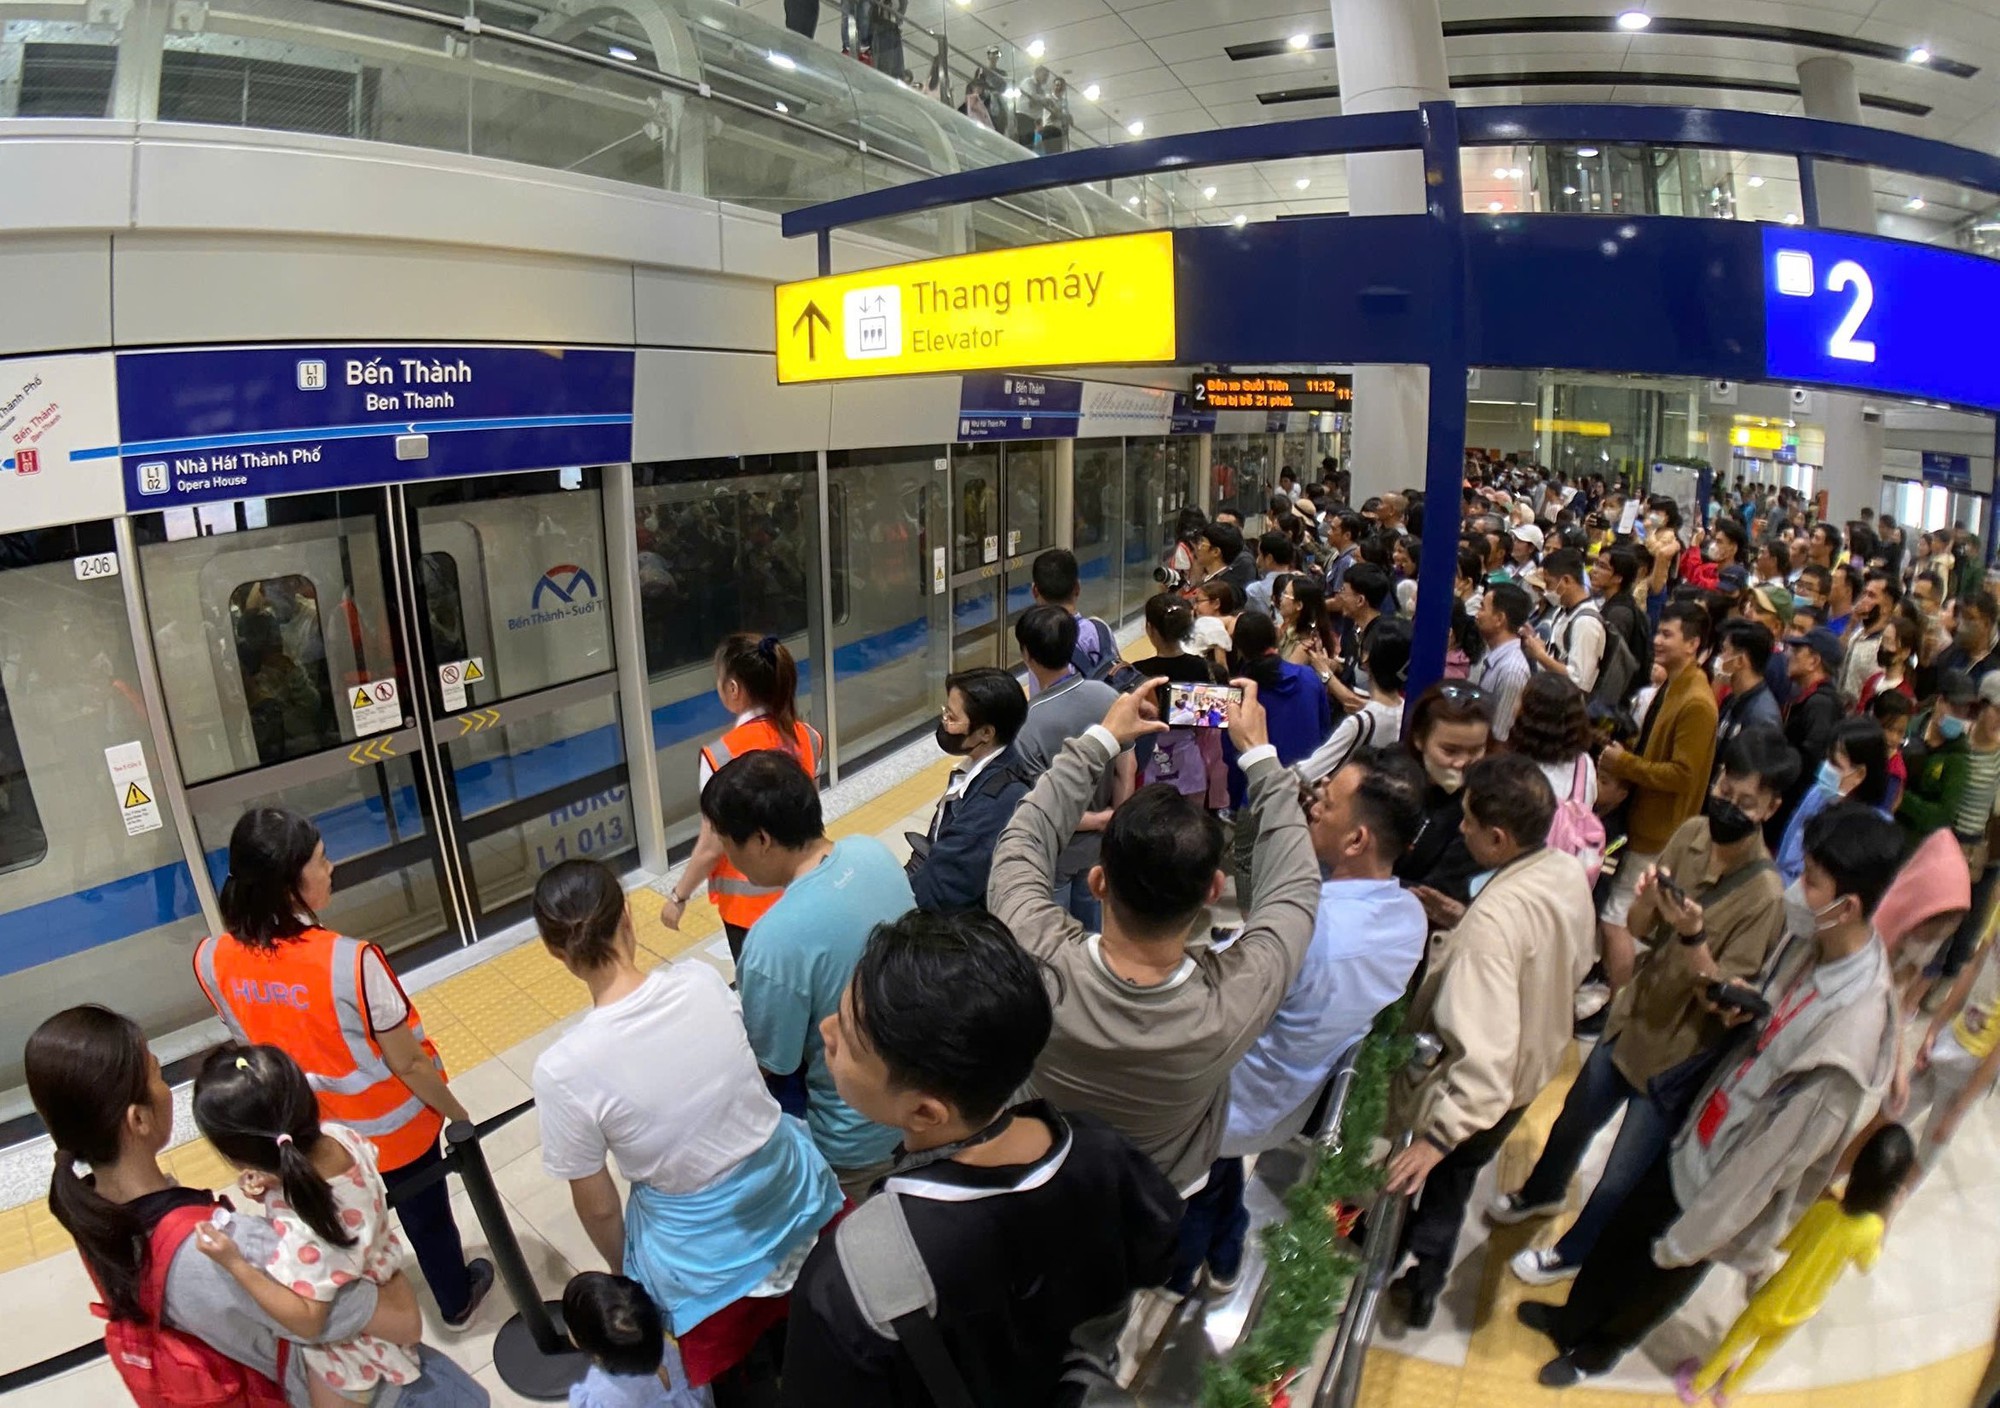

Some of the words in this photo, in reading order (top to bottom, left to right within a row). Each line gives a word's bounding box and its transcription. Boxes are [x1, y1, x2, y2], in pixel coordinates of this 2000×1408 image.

[912, 281, 1010, 315] Thang
[1027, 263, 1104, 307] máy
[1827, 260, 1876, 363] 2
[912, 327, 1004, 352] Elevator
[306, 365, 318, 375] L1
[346, 357, 394, 385] Bến
[401, 358, 472, 384] Thành
[306, 376, 318, 386] 01
[1306, 381, 1336, 392] 11:12
[366, 393, 399, 411] Ben
[404, 392, 454, 408] Thanh
[1195, 383, 1206, 400] 2
[13, 426, 32, 444] Bến
[30, 402, 59, 428] Thành
[176, 457, 208, 475] Nhà
[212, 454, 239, 471] Hát
[242, 451, 288, 469] Thành
[292, 445, 322, 464] Phố
[147, 467, 160, 478] L1
[147, 479, 161, 490] 02
[177, 479, 210, 492] Opera
[213, 474, 248, 487] House
[80, 556, 111, 576] 2-06
[577, 816, 624, 853] 013
[230, 978, 310, 1011] HURC
